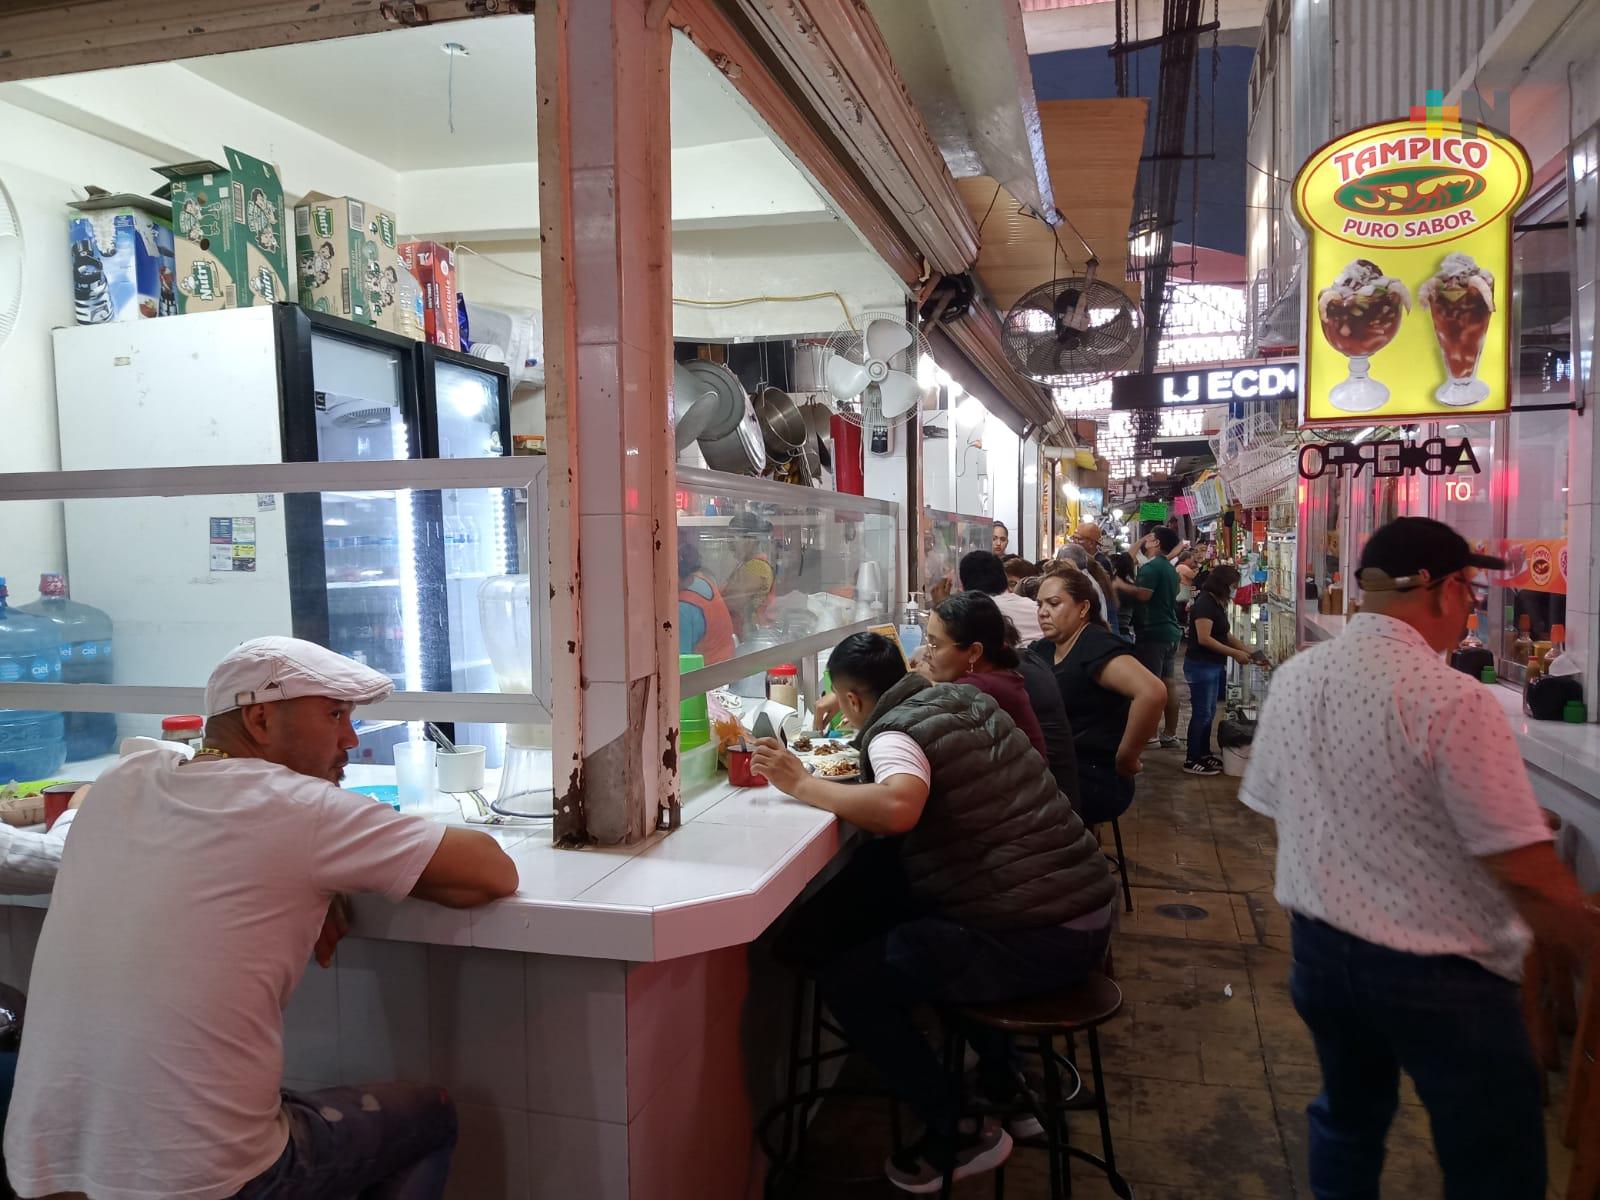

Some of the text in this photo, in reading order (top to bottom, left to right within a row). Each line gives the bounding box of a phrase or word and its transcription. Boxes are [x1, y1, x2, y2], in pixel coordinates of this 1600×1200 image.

[1333, 136, 1488, 182] TAMPICO
[316, 206, 330, 238] Nutri
[1343, 210, 1476, 239] PURO SABOR
[193, 260, 213, 300] Nutri
